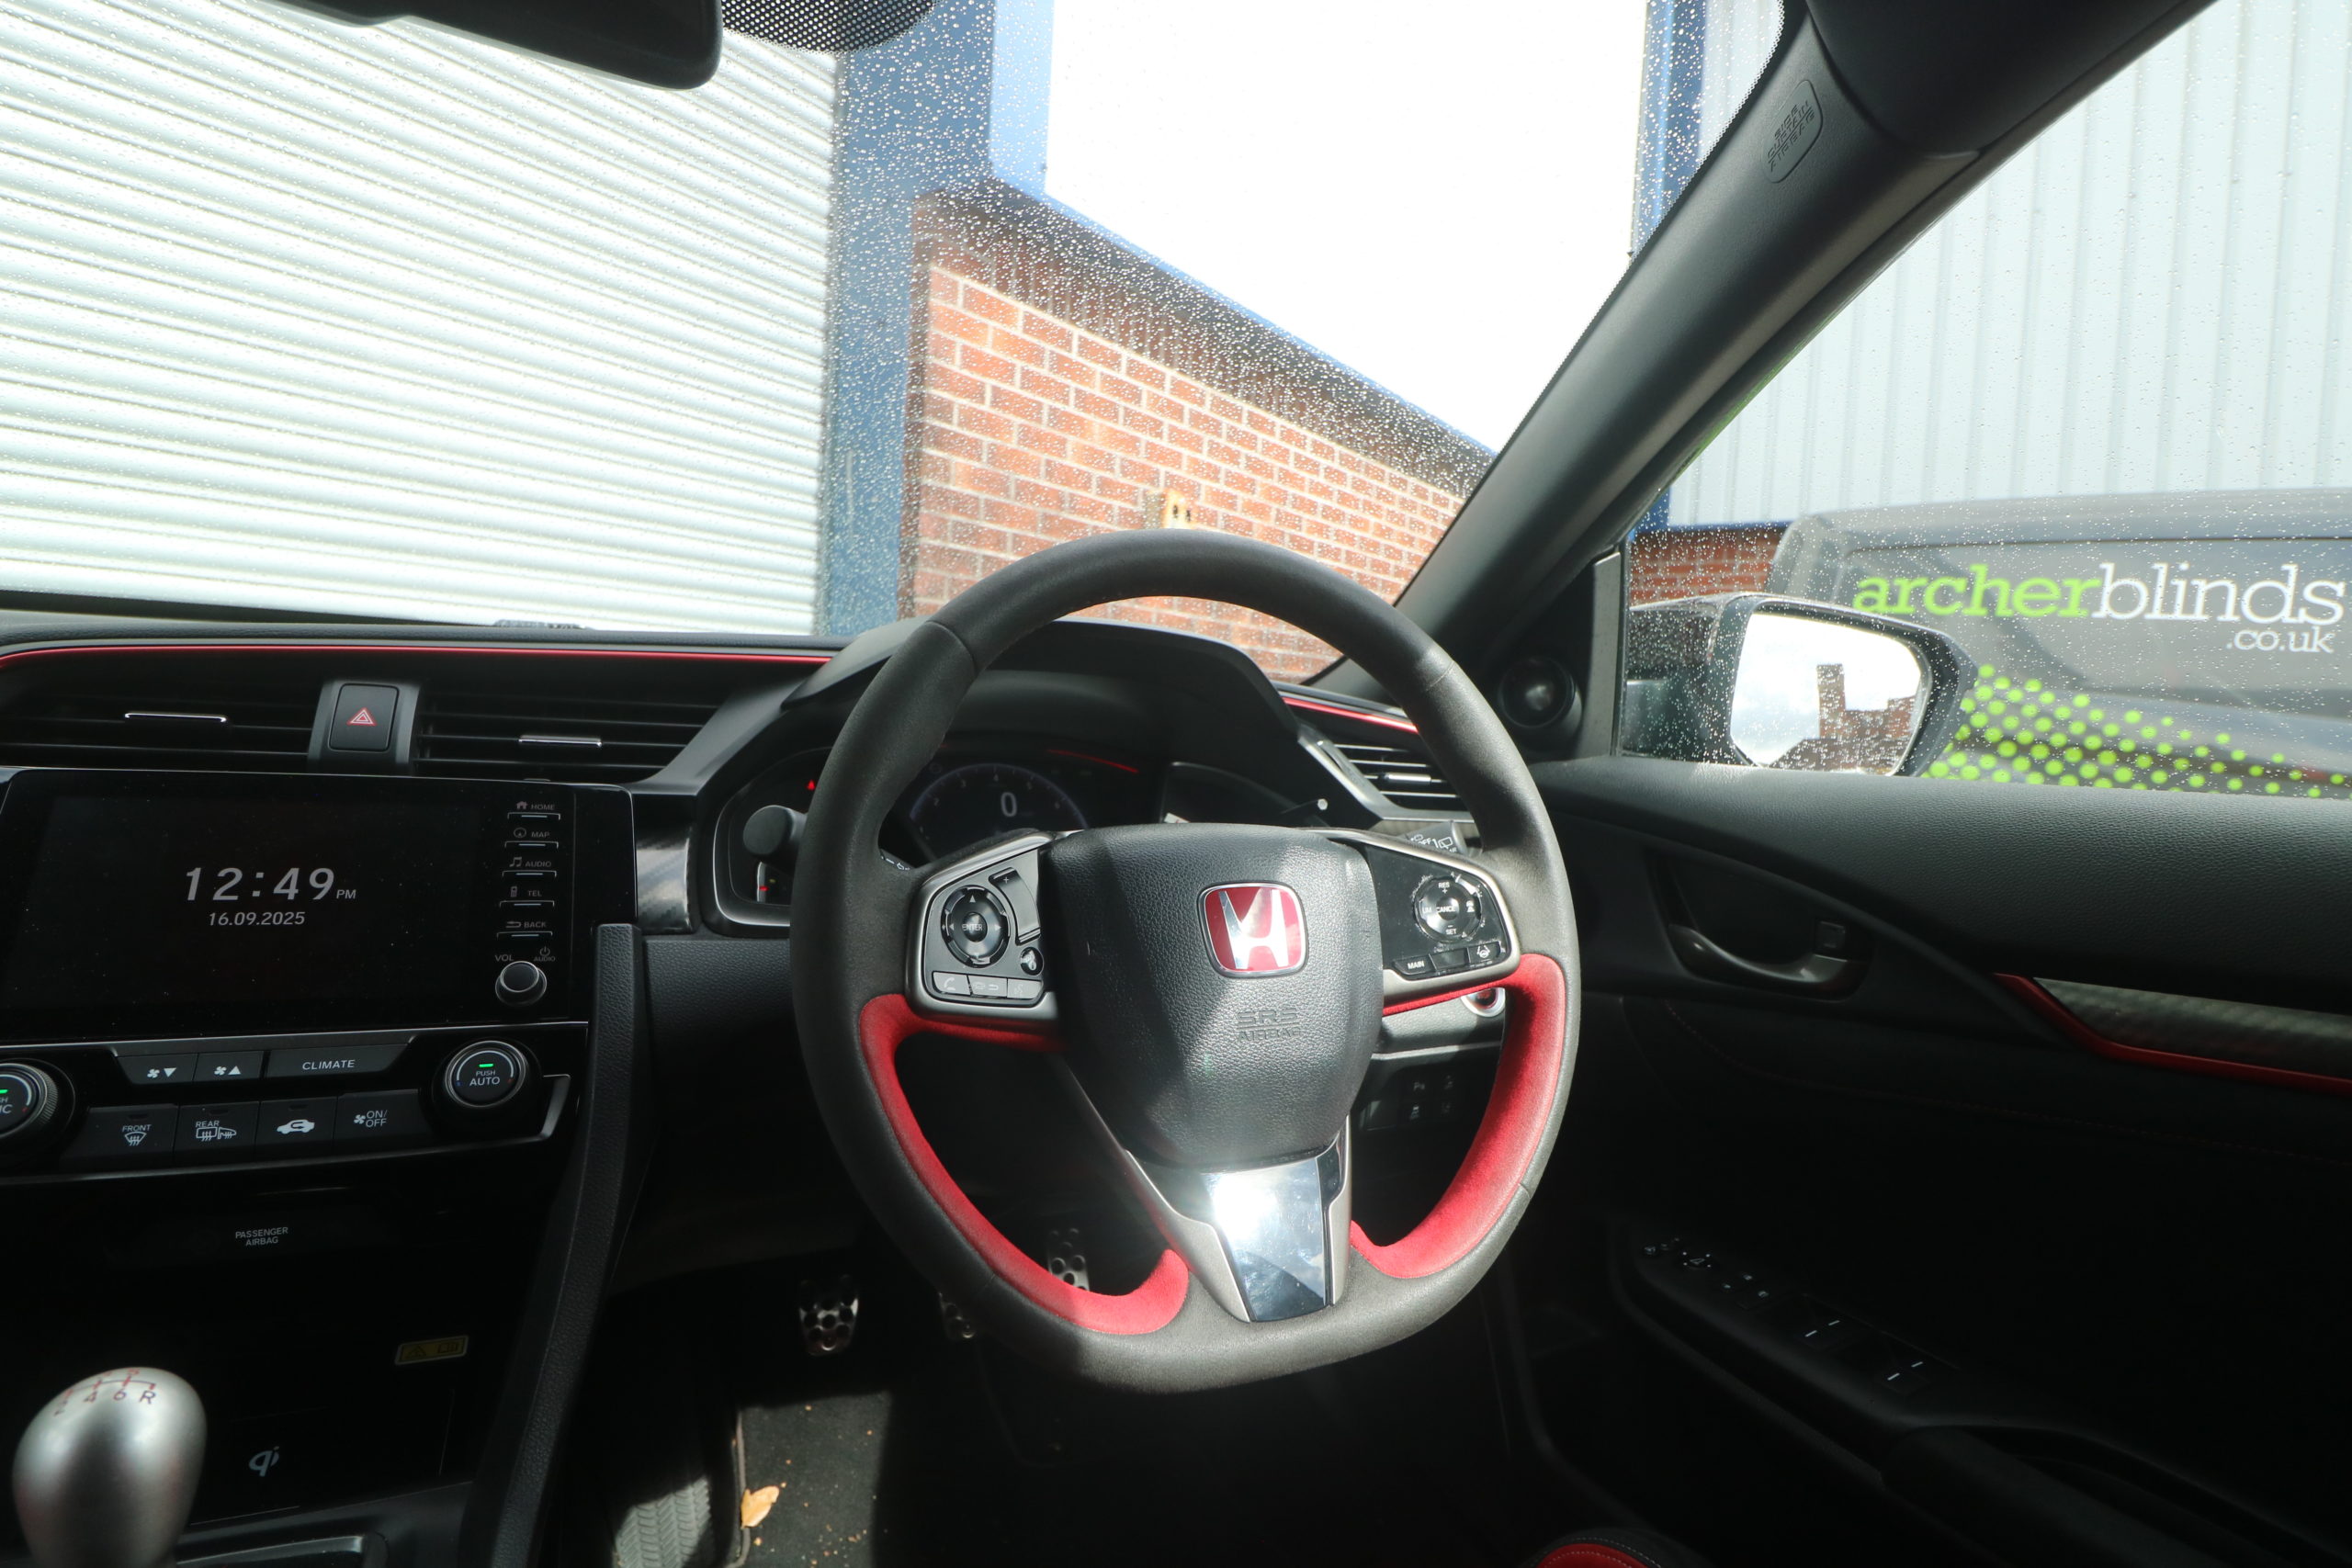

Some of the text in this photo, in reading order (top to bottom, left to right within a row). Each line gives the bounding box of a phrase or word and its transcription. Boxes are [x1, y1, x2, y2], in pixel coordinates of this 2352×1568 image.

[2226, 626, 2335, 653] .co.uk
[1000, 791, 1019, 818] 0
[186, 867, 356, 901] 12:49 PM
[527, 889, 543, 897] TEL
[209, 911, 306, 927] 16.09.2025
[961, 923, 983, 932] ENTER
[1407, 960, 1425, 970] MAIN
[1237, 1007, 1298, 1024] SRS
[301, 1059, 356, 1071] CLIMATE
[469, 1077, 501, 1088] AUTO
[366, 1109, 388, 1119] ON/
[195, 1120, 220, 1129] REAR
[365, 1117, 388, 1128] OFF
[121, 1124, 153, 1134] FRONT
[235, 1226, 288, 1239] PASSENGER
[245, 1235, 279, 1247] AIRBAG
[113, 1389, 128, 1402] 6
[140, 1390, 157, 1404] R
